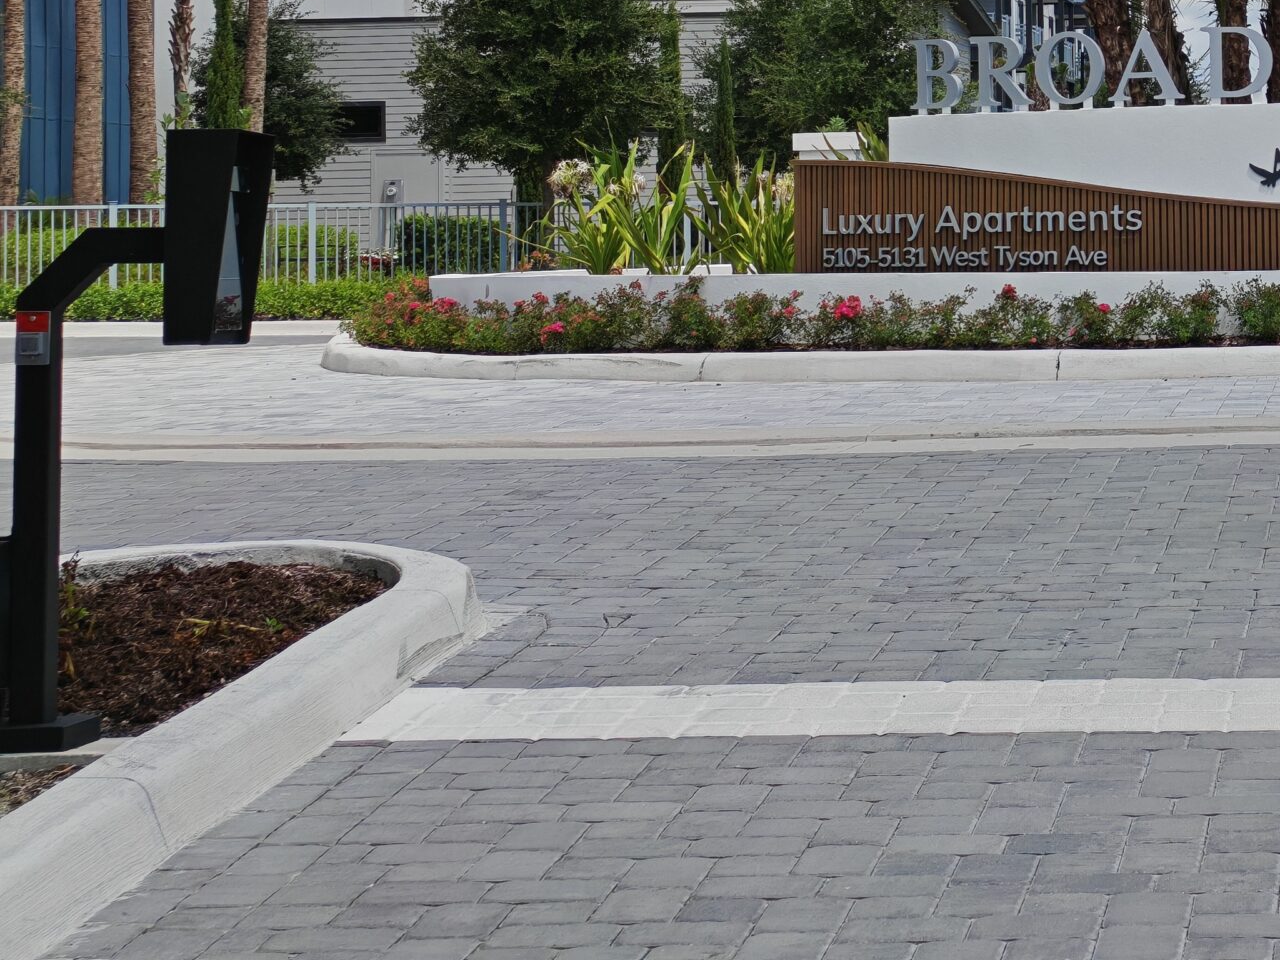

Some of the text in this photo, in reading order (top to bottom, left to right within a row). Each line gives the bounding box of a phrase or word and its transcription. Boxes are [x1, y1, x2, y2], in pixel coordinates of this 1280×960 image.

[822, 204, 1143, 241] Luxury Apartments
[822, 245, 1108, 272] 5105-5131 West Tyson Ave
